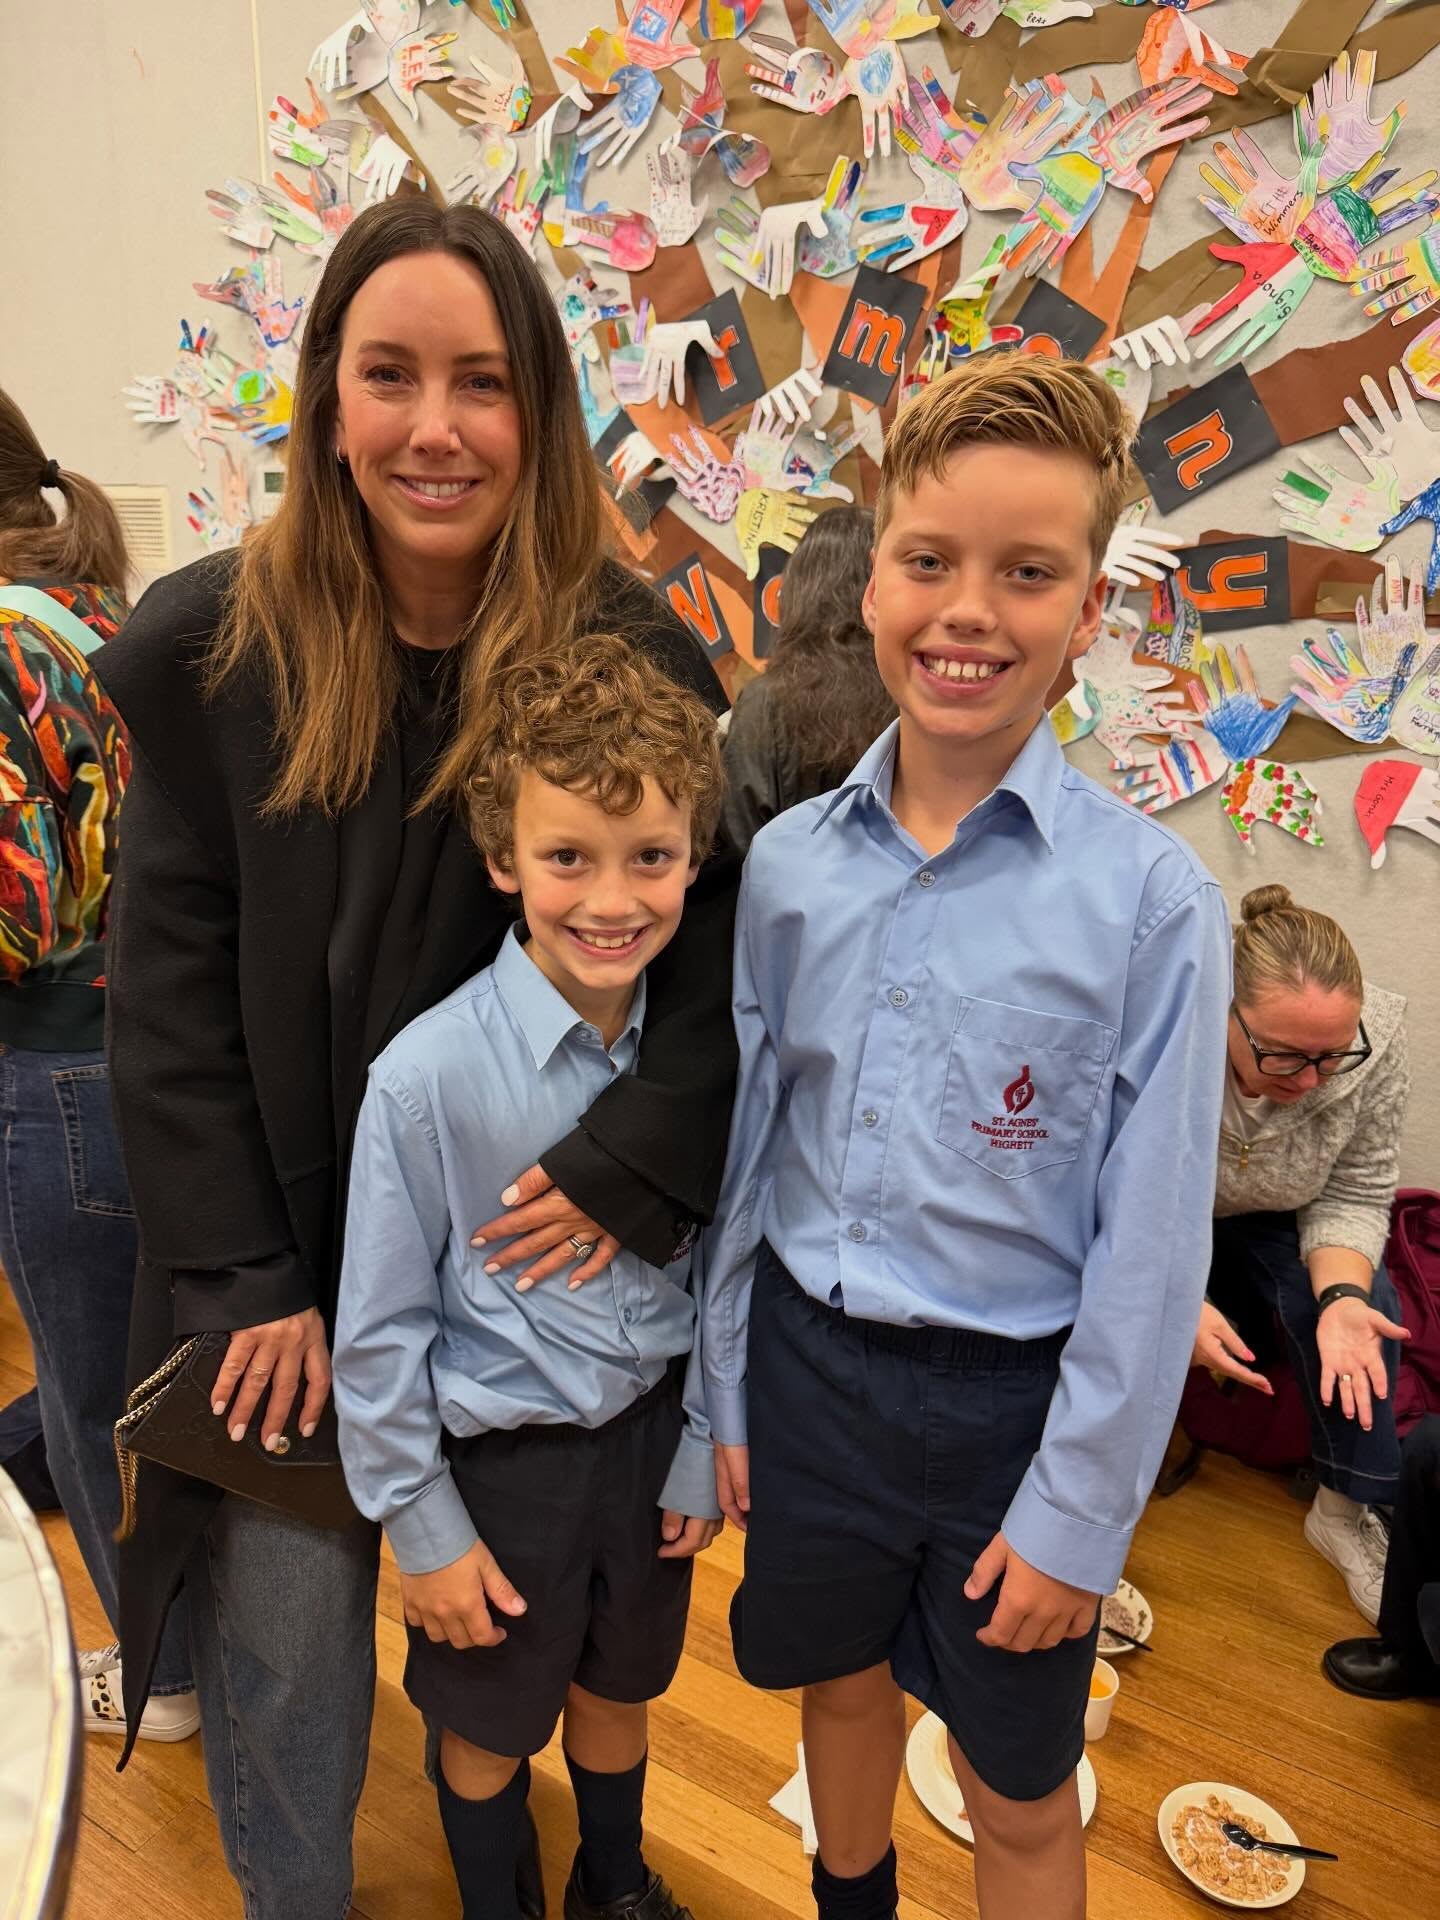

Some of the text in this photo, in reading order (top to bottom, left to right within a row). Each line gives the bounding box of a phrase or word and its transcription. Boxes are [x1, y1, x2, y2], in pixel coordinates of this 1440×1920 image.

[1252, 270, 1295, 320] Signora
[743, 492, 770, 550] KRISTINA
[1380, 775, 1396, 791] Mrs
[971, 1119, 1050, 1139] PRIMARY SCHOOL
[990, 1138, 1035, 1150] HIGHETT
